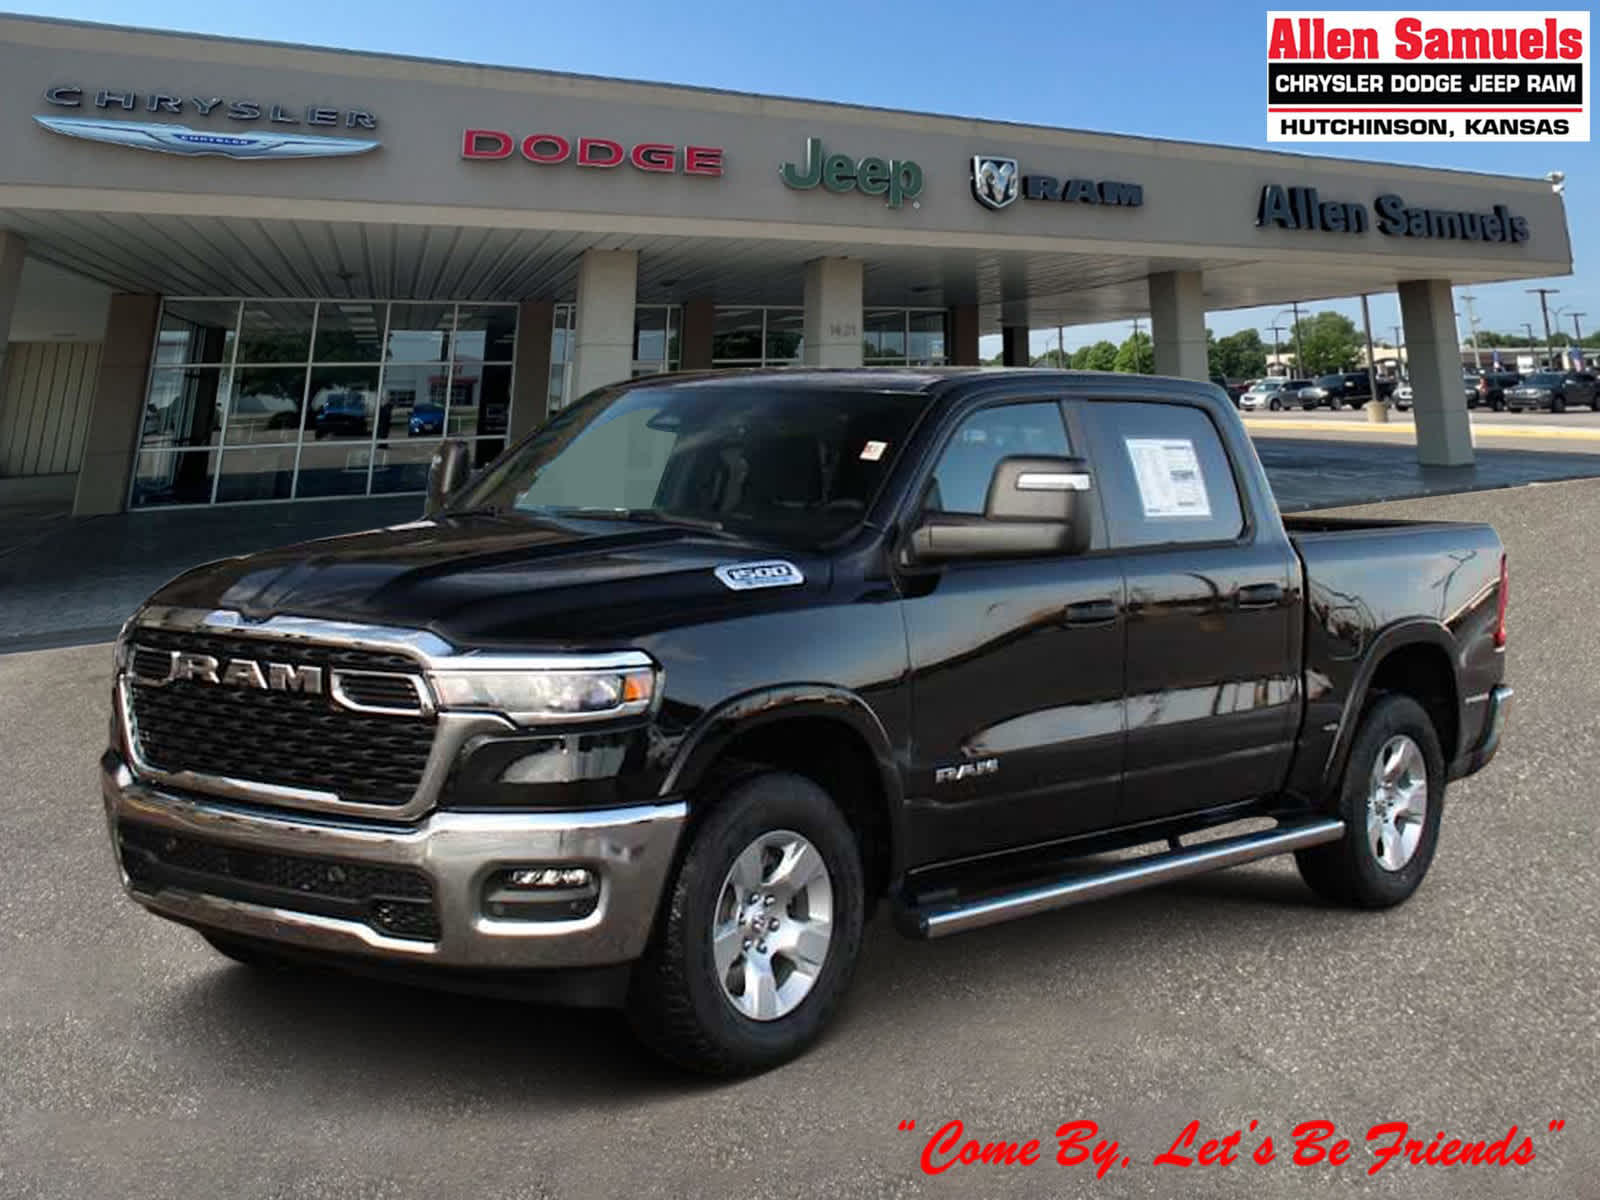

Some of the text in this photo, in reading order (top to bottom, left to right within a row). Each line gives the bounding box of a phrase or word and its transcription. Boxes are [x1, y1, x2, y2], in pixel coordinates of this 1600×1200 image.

[46, 86, 377, 128] CHRYSLER
[462, 128, 725, 177] DODGE
[780, 137, 924, 209] Jeep
[1023, 175, 1143, 207] RAM
[1256, 184, 1530, 242] Allen Samuels
[170, 651, 323, 694] RAM
[935, 758, 998, 784] RAM
